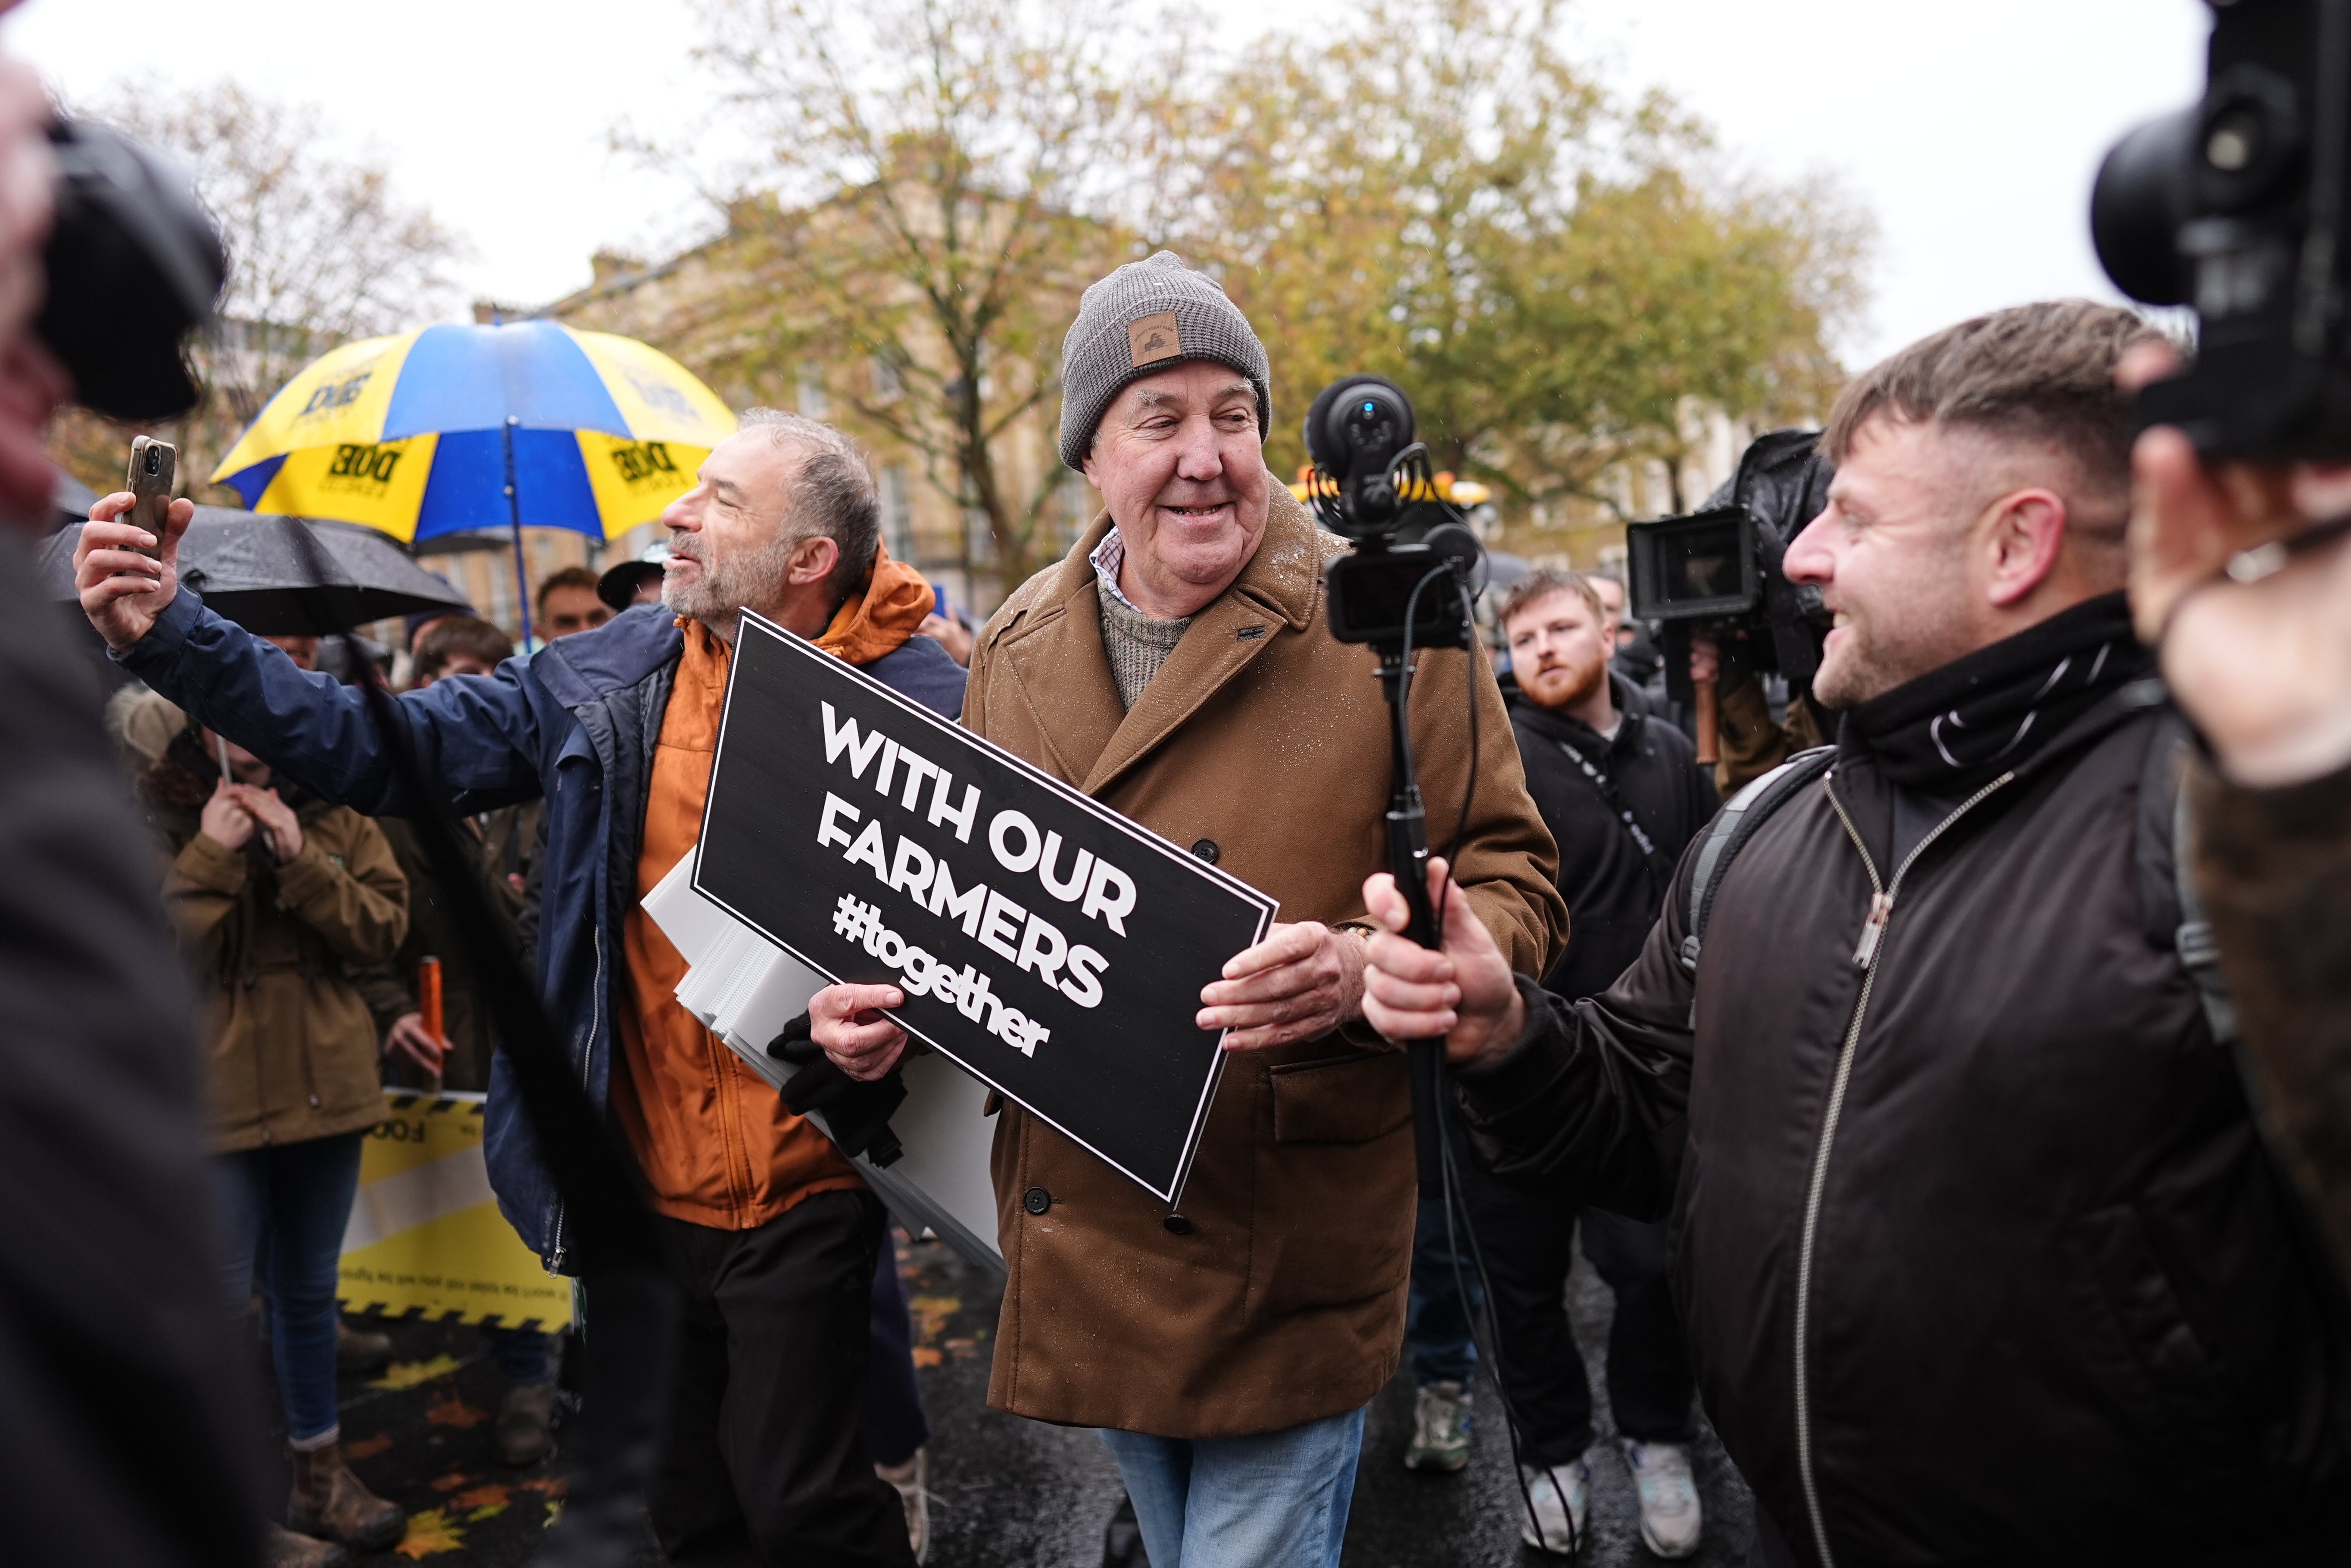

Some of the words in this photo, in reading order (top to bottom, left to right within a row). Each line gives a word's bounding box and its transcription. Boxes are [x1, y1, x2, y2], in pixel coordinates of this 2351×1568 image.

[1134, 329, 1147, 342] DIDDLY
[817, 791, 1109, 1008] FARMERS
[821, 700, 981, 843] WITH
[989, 810, 1137, 937] OUR
[833, 893, 1050, 1058] #together
